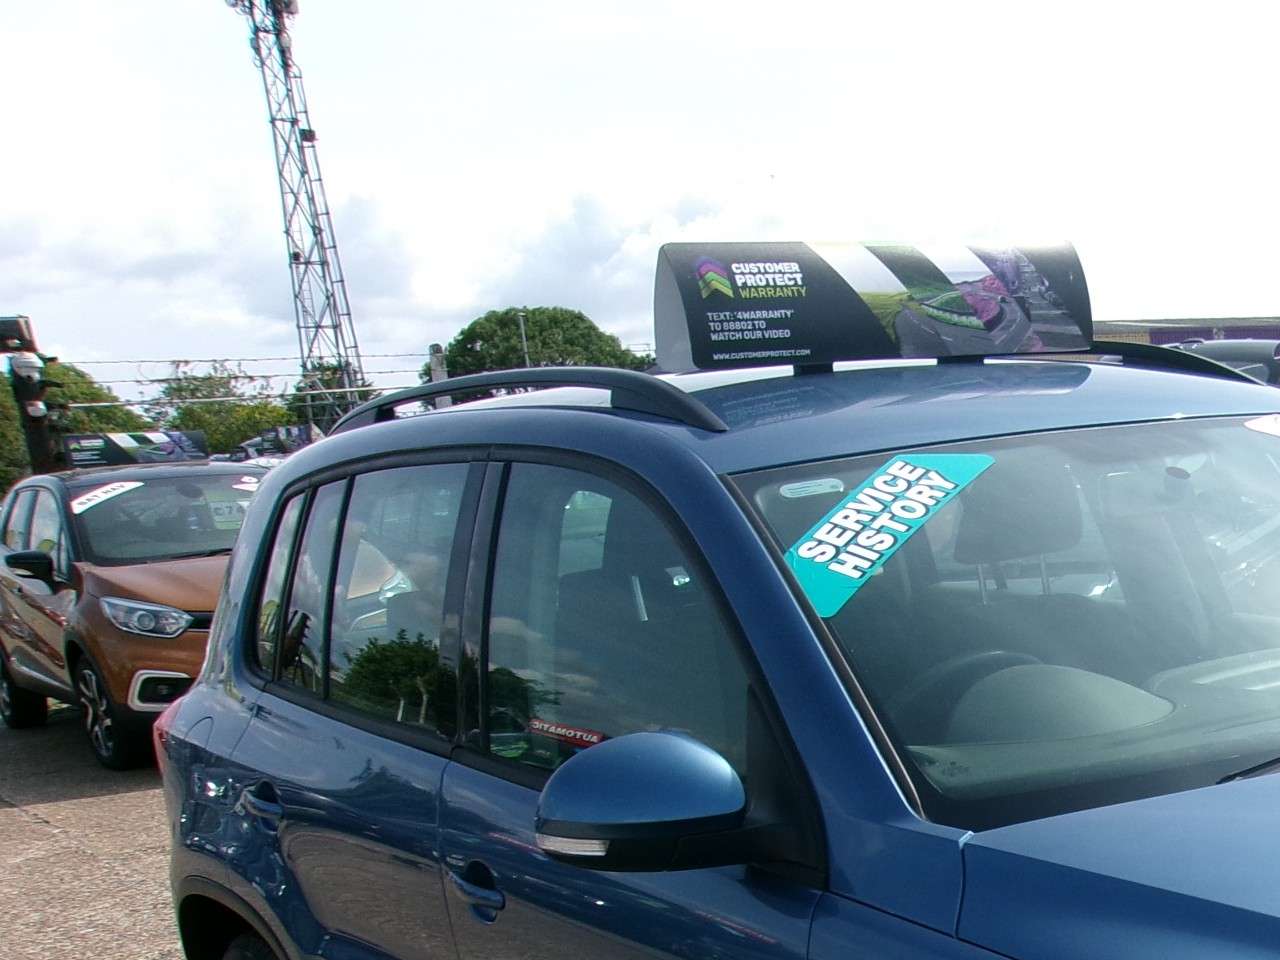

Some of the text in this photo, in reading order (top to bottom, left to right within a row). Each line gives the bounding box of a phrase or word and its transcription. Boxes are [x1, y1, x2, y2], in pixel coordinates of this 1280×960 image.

[731, 262, 800, 274] CUSTOMER
[734, 273, 803, 287] PROTECT
[739, 286, 806, 299] WARRANTY
[709, 322, 722, 331] TO
[753, 320, 766, 329] TO
[710, 329, 791, 341] WATCH OUR VIDEO
[797, 460, 926, 563] SERVICE
[828, 470, 957, 579] HISTORY
